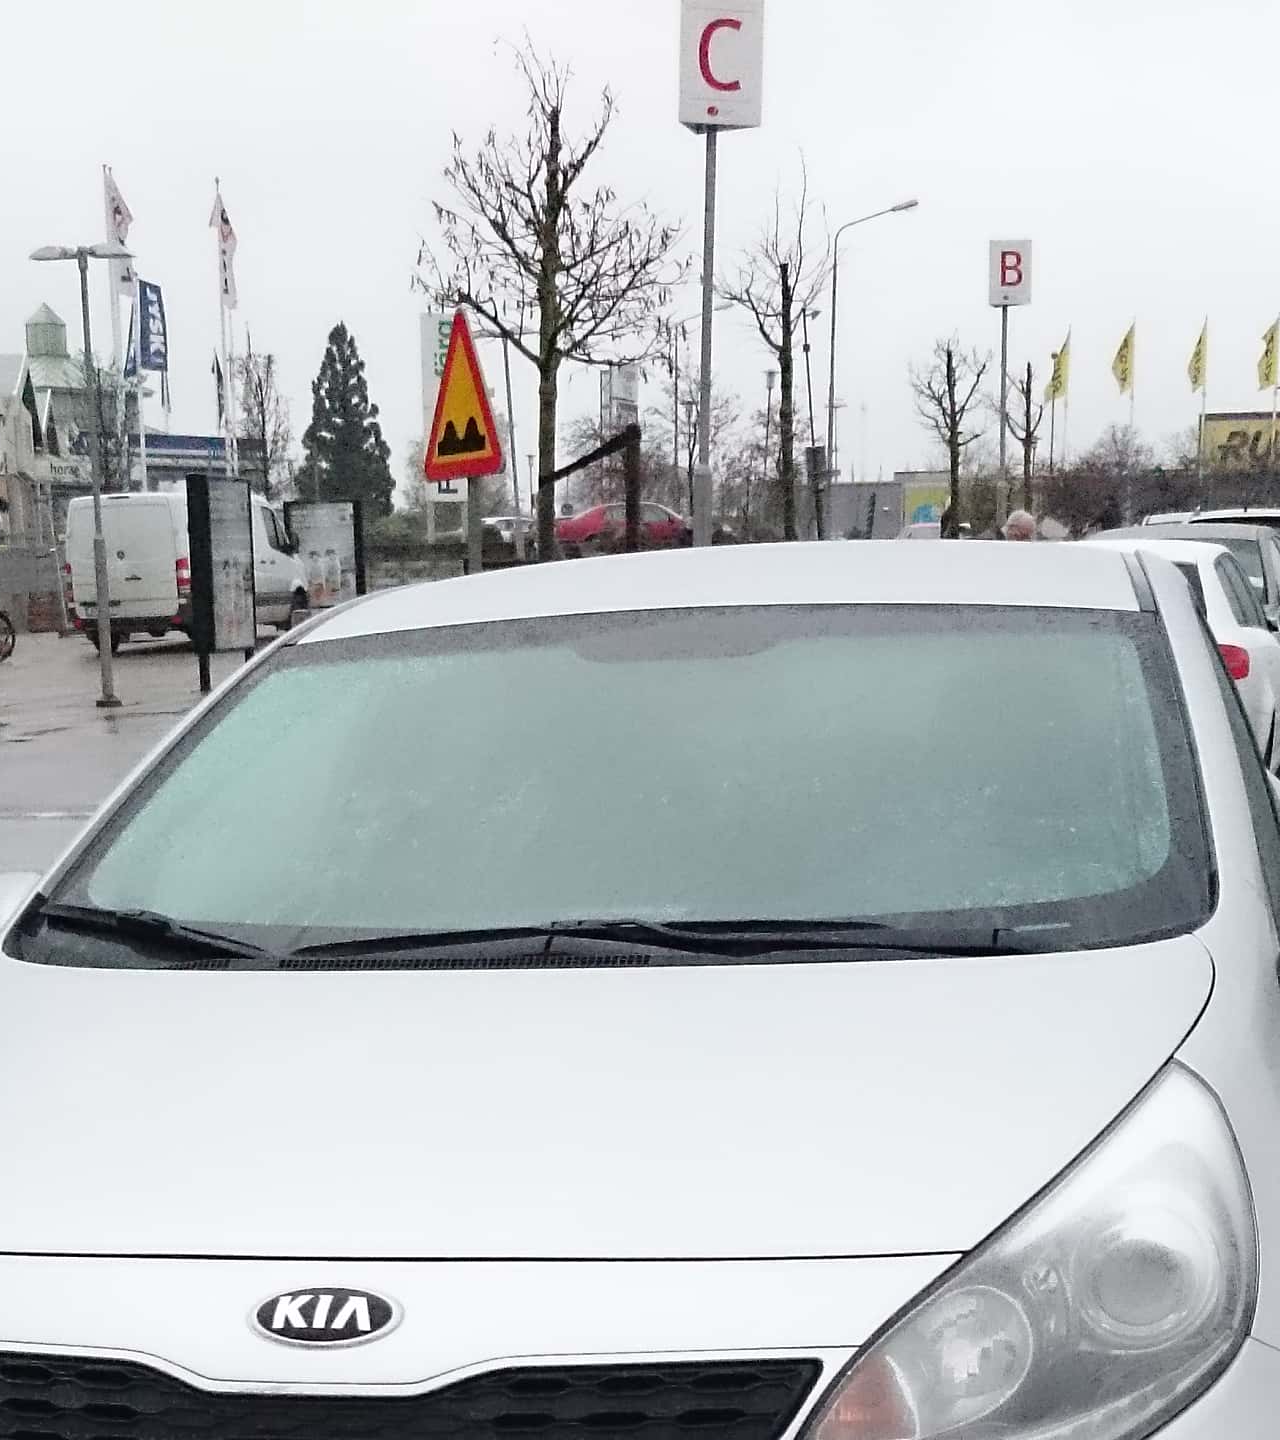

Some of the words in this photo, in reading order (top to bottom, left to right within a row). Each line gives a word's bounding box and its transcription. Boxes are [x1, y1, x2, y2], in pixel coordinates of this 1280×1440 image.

[699, 18, 743, 91] C
[1000, 251, 1023, 286] B
[271, 1294, 373, 1332] KIA
